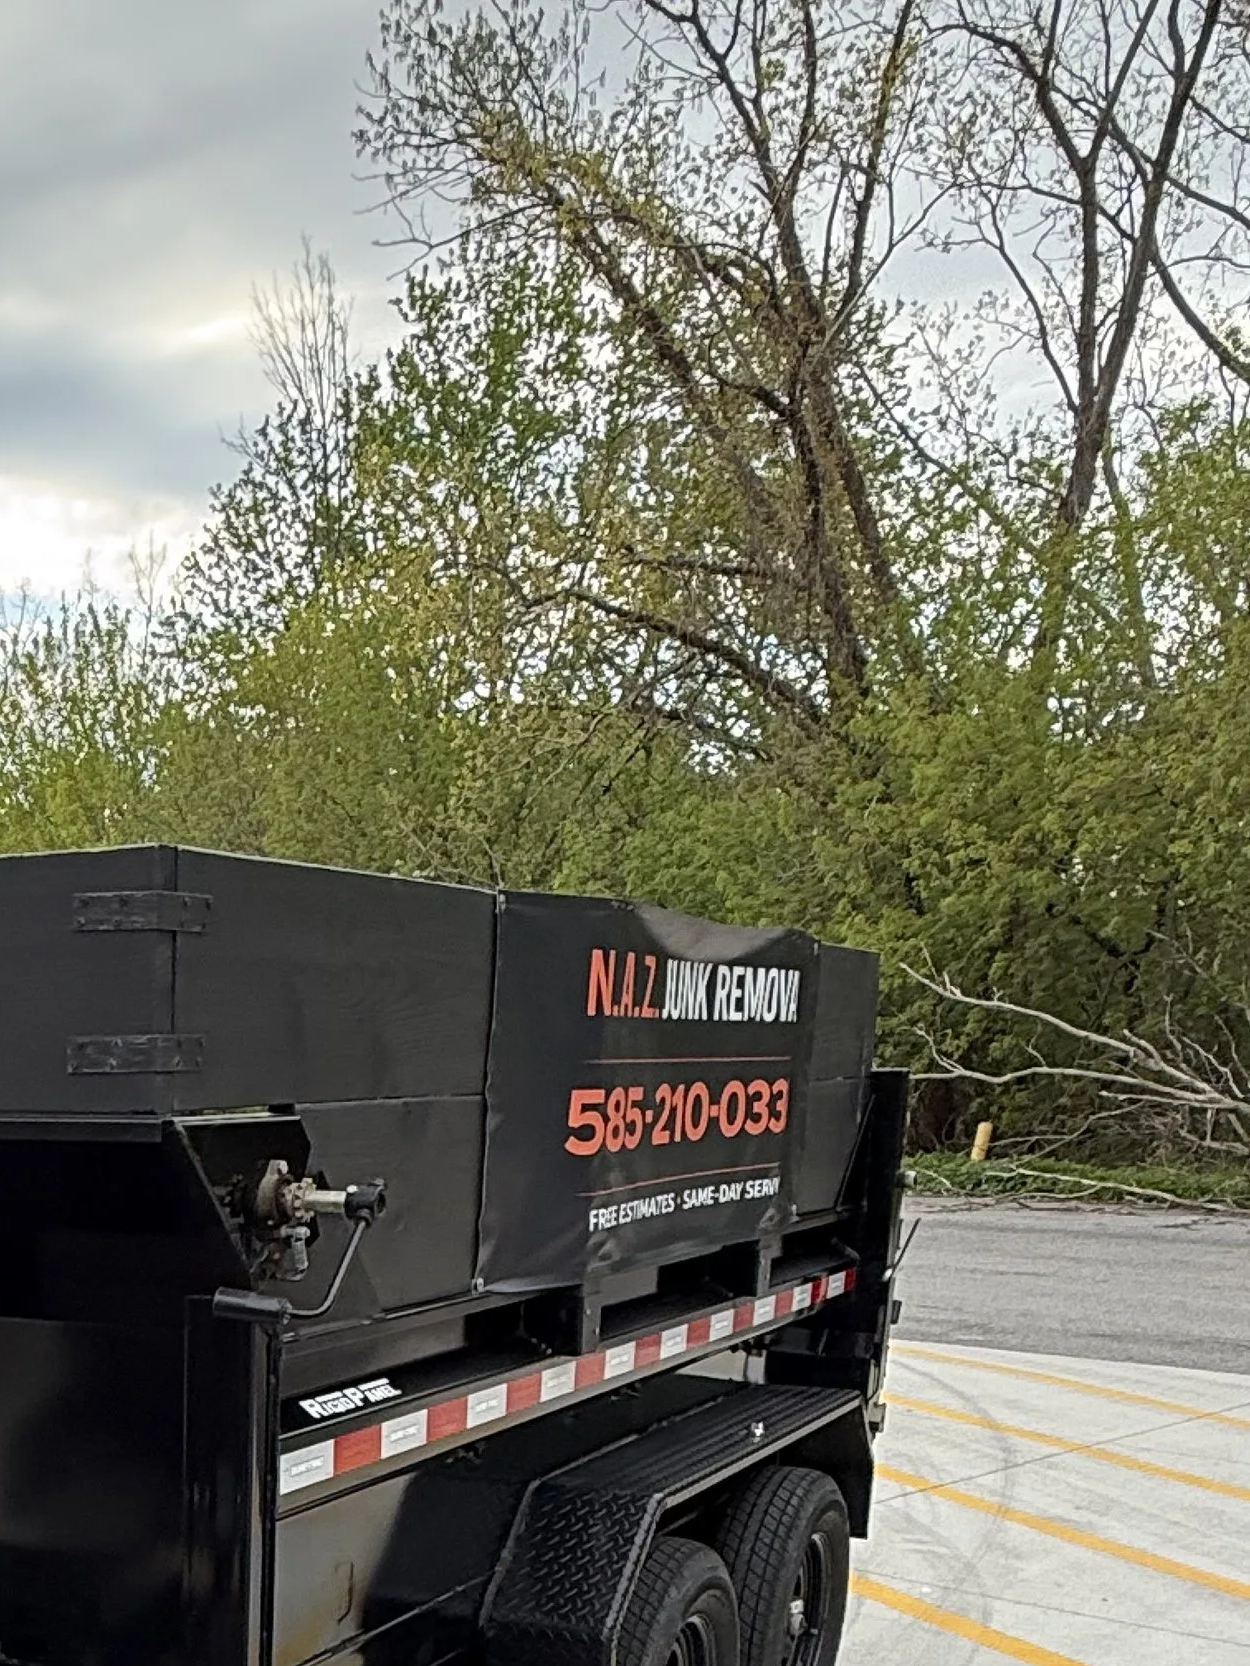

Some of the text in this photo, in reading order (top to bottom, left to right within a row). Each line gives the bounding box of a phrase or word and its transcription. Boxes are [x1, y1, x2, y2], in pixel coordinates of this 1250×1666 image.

[661, 958, 714, 1021] JUNK
[564, 1077, 789, 1157] 585-210-033
[588, 1203, 618, 1233] FREE
[618, 1192, 675, 1225] ESTIMATES
[681, 1181, 744, 1211] SAME-DAY
